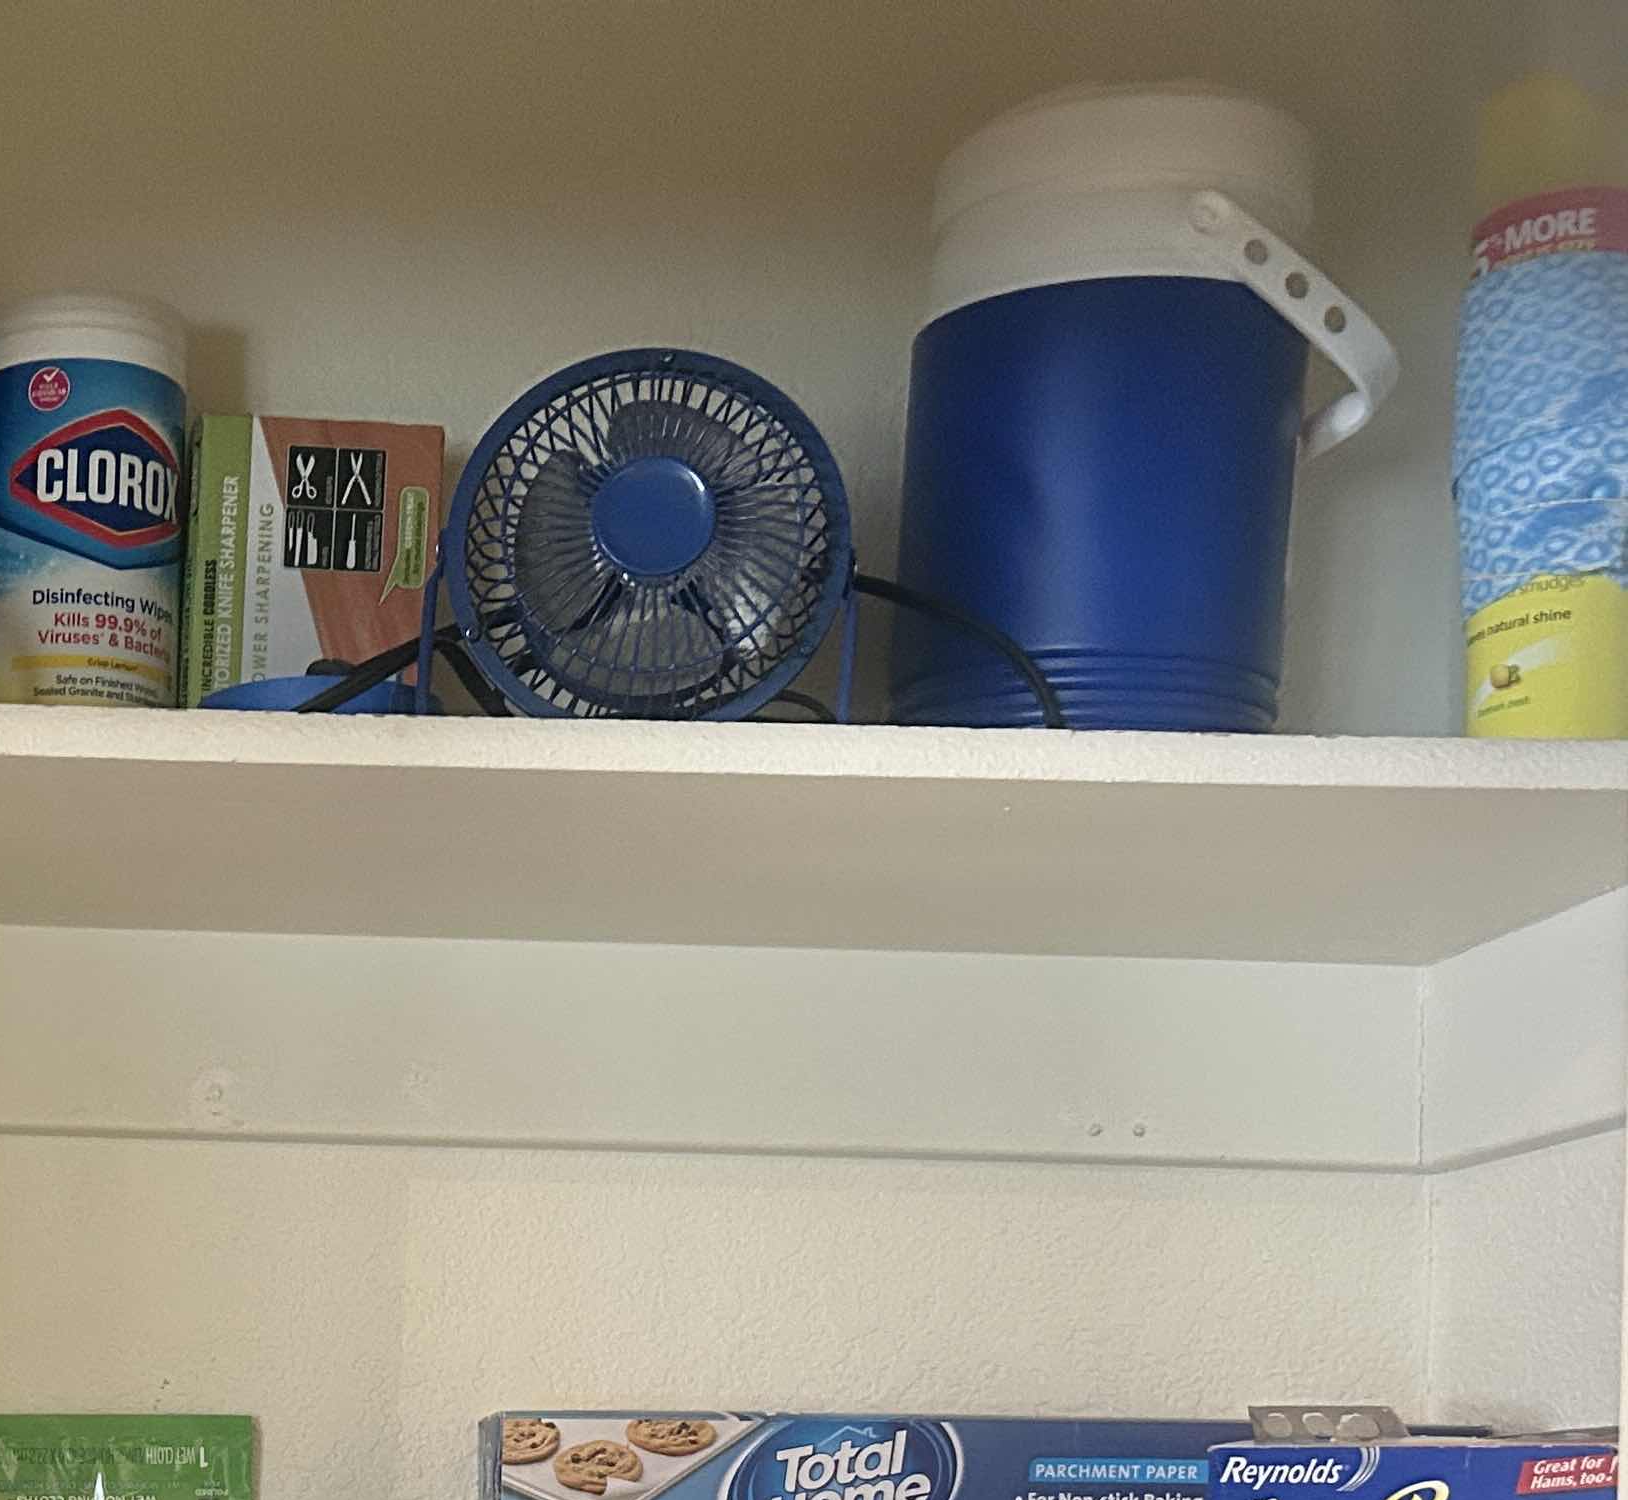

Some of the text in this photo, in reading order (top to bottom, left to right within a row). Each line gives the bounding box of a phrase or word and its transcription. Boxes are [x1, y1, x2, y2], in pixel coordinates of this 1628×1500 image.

[1504, 208, 1596, 254] MORE
[36, 448, 179, 523] CLOROX
[216, 475, 239, 618] KNIFE SHARPENER
[254, 503, 274, 625] SHARPENING
[32, 588, 135, 613] Disinfecting
[54, 612, 163, 642] Kills 99.9% of
[202, 559, 217, 692] INCREDIBLE CORDLESS
[1487, 609, 1572, 637] natural shine
[108, 632, 119, 648] &
[56, 674, 93, 686] Safe on
[776, 1429, 907, 1492] Total
[1035, 1463, 1198, 1480] PARCHMENT PAPER
[1220, 1456, 1343, 1491] Reynolds
[1534, 1456, 1605, 1474] Great for
[1530, 1473, 1577, 1490] Hams,
